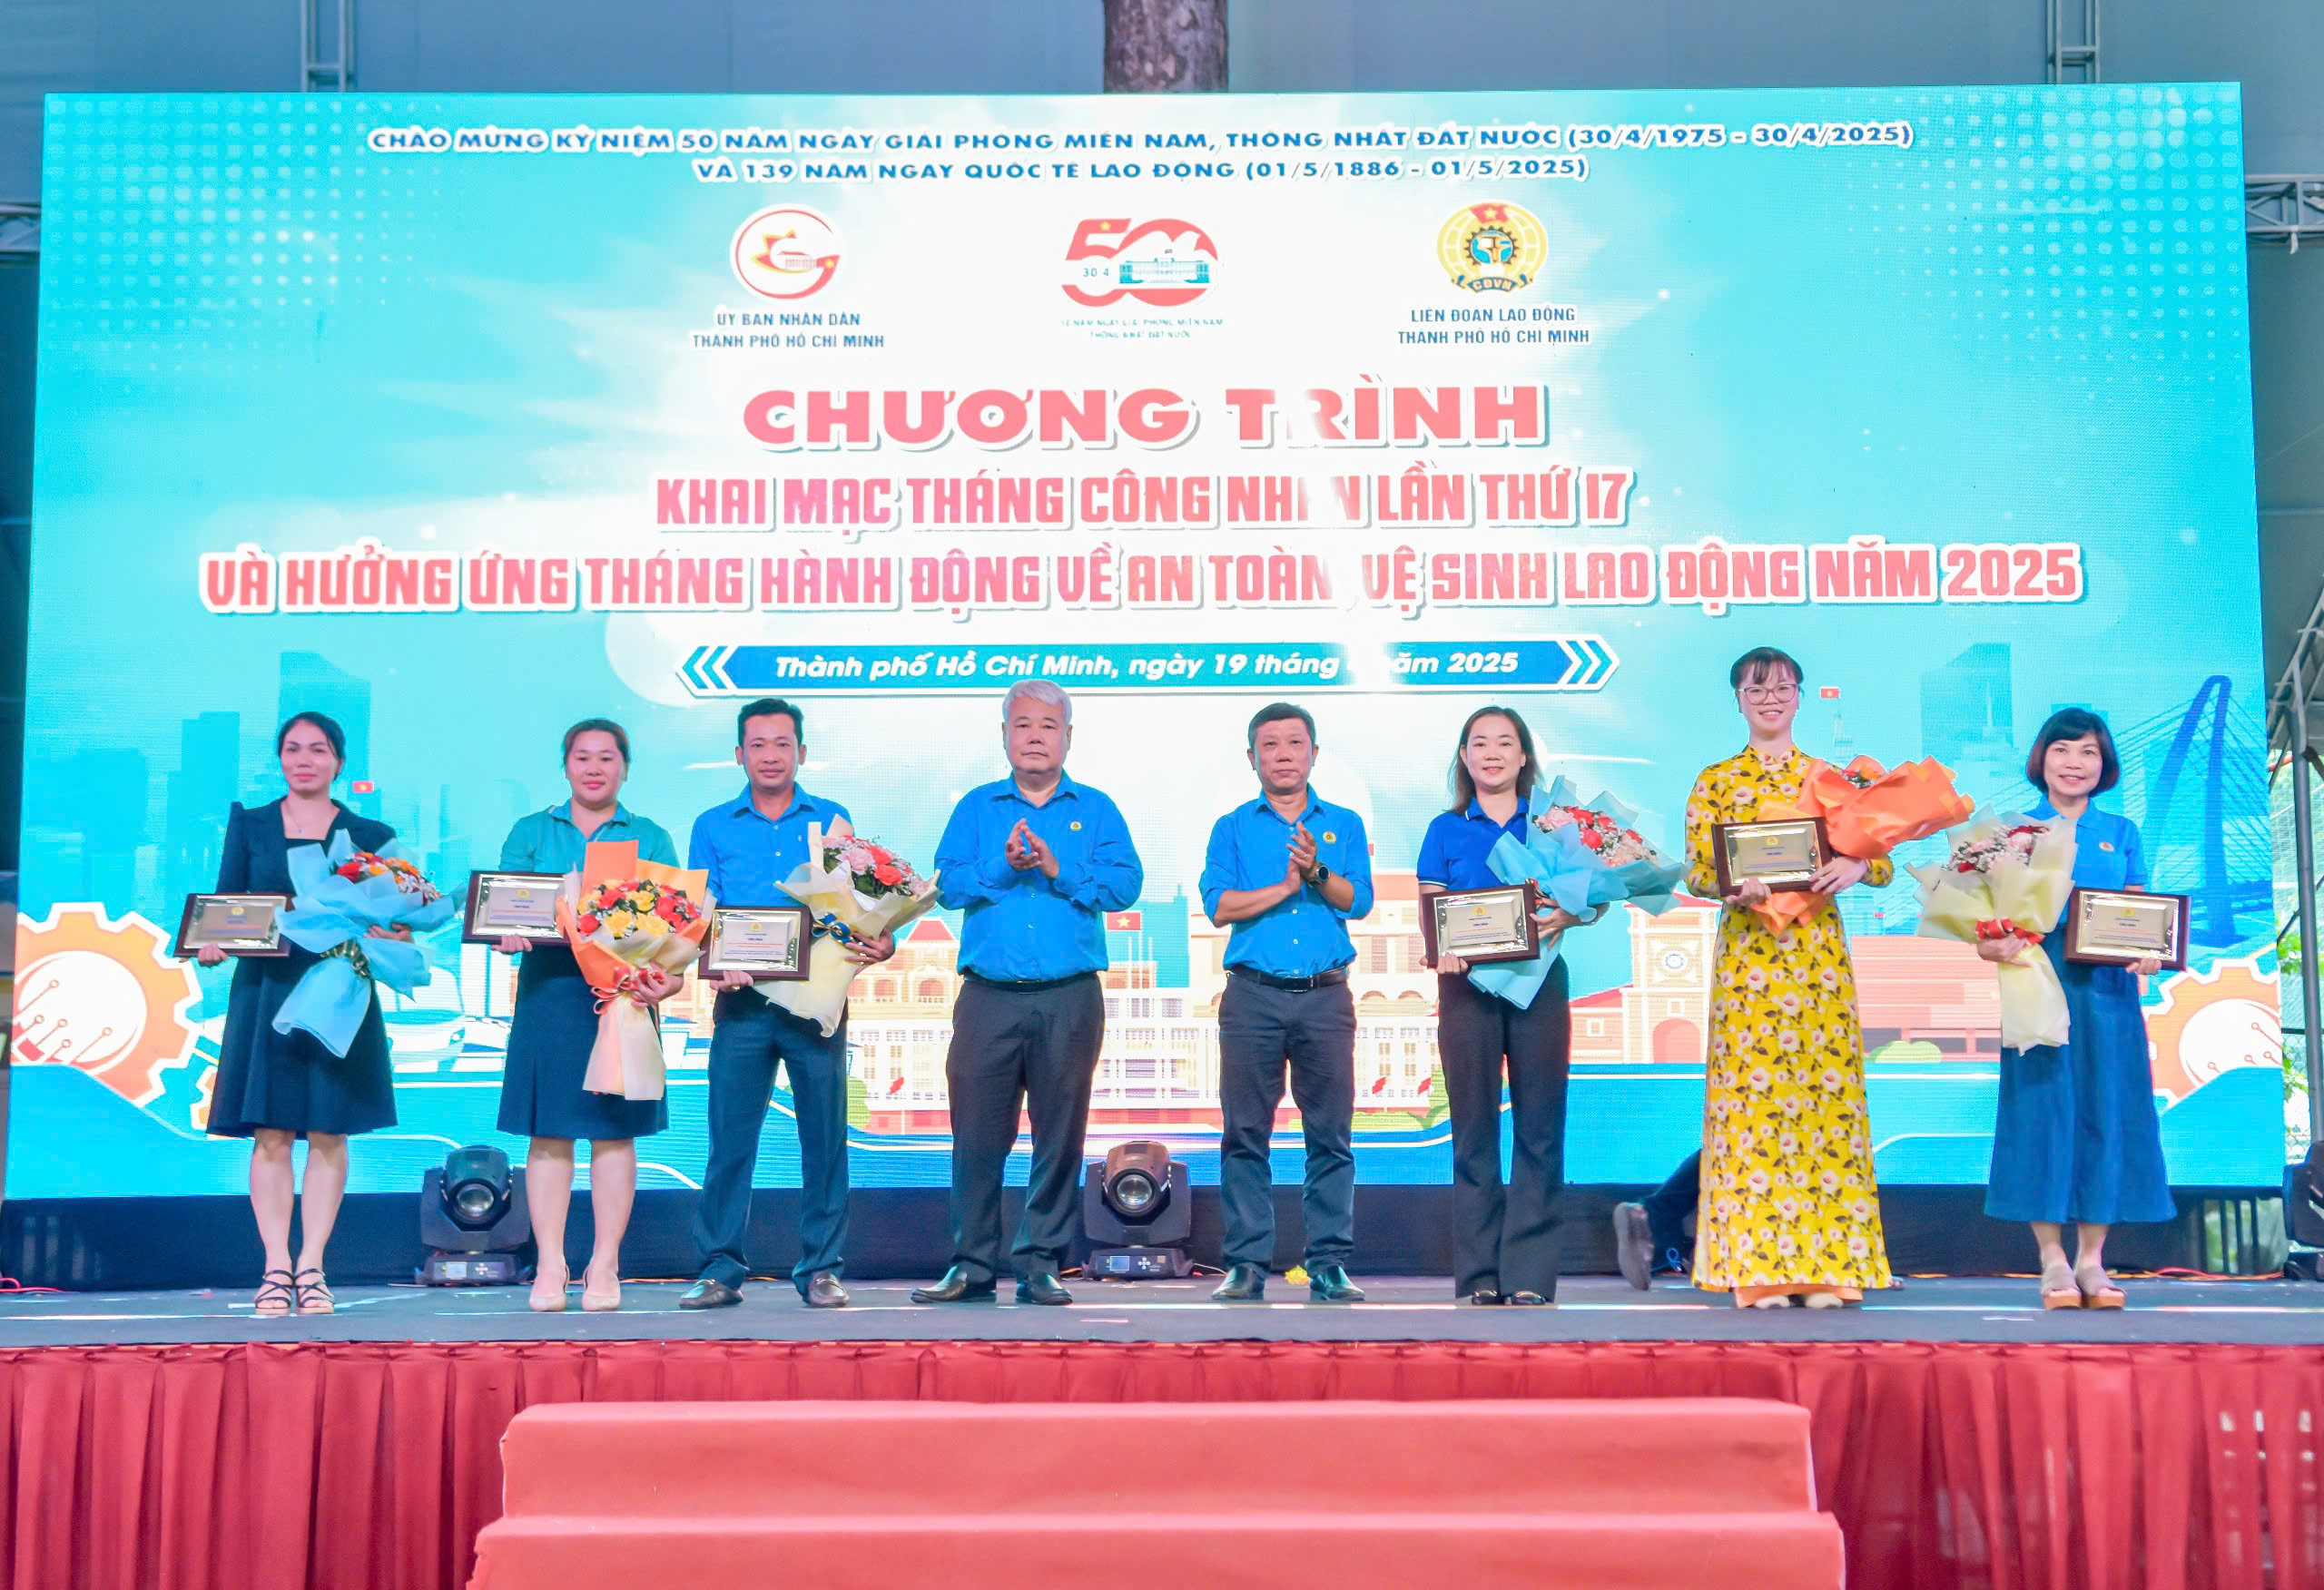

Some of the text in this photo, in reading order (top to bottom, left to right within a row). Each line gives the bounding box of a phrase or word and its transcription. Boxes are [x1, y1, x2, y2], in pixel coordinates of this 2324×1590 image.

[682, 134, 713, 149] 50
[1145, 133, 1215, 152] NAM,
[1569, 129, 1723, 148] (30/4/1975
[1755, 125, 1913, 146] 30/4/2025)
[746, 164, 793, 179] 139
[1090, 163, 1141, 178] LAO
[1246, 161, 1399, 181] (01/5/1886
[1431, 159, 1590, 180] 01/5/2025)
[743, 314, 773, 326] BAN
[1499, 309, 1527, 321] LAO
[842, 334, 884, 348] MINH
[1547, 329, 1590, 344] MINH
[743, 373, 1539, 444] CHƯƠNG TRÌNH
[657, 478, 766, 525] KHAI
[783, 477, 891, 536] MẠC
[906, 468, 1064, 525] THÁNG
[1081, 468, 1210, 524] CÔNG
[1226, 475, 1361, 522] NHN
[1377, 460, 1465, 522] LẦN
[1479, 464, 1571, 520] THỨ
[207, 551, 269, 606] VÀ
[286, 544, 452, 606] HƯỞNG
[469, 551, 568, 604] ỨNG
[585, 551, 743, 604] THÁNG
[761, 548, 891, 604] HÀNH
[909, 548, 1039, 621] ĐỘNG
[1057, 542, 1112, 603] VỀ
[1128, 555, 1194, 602] AN
[1363, 545, 1417, 612] VỆ
[1432, 553, 1548, 600] SINH
[1564, 552, 1649, 599] LAO
[1667, 543, 1799, 610] ĐỘNG
[1815, 541, 1931, 597] NĂM
[1947, 548, 2076, 596] 2025
[776, 650, 1519, 681] Thành phố Hồ Chí Minh, ngày 19 tháng ăm 2025
